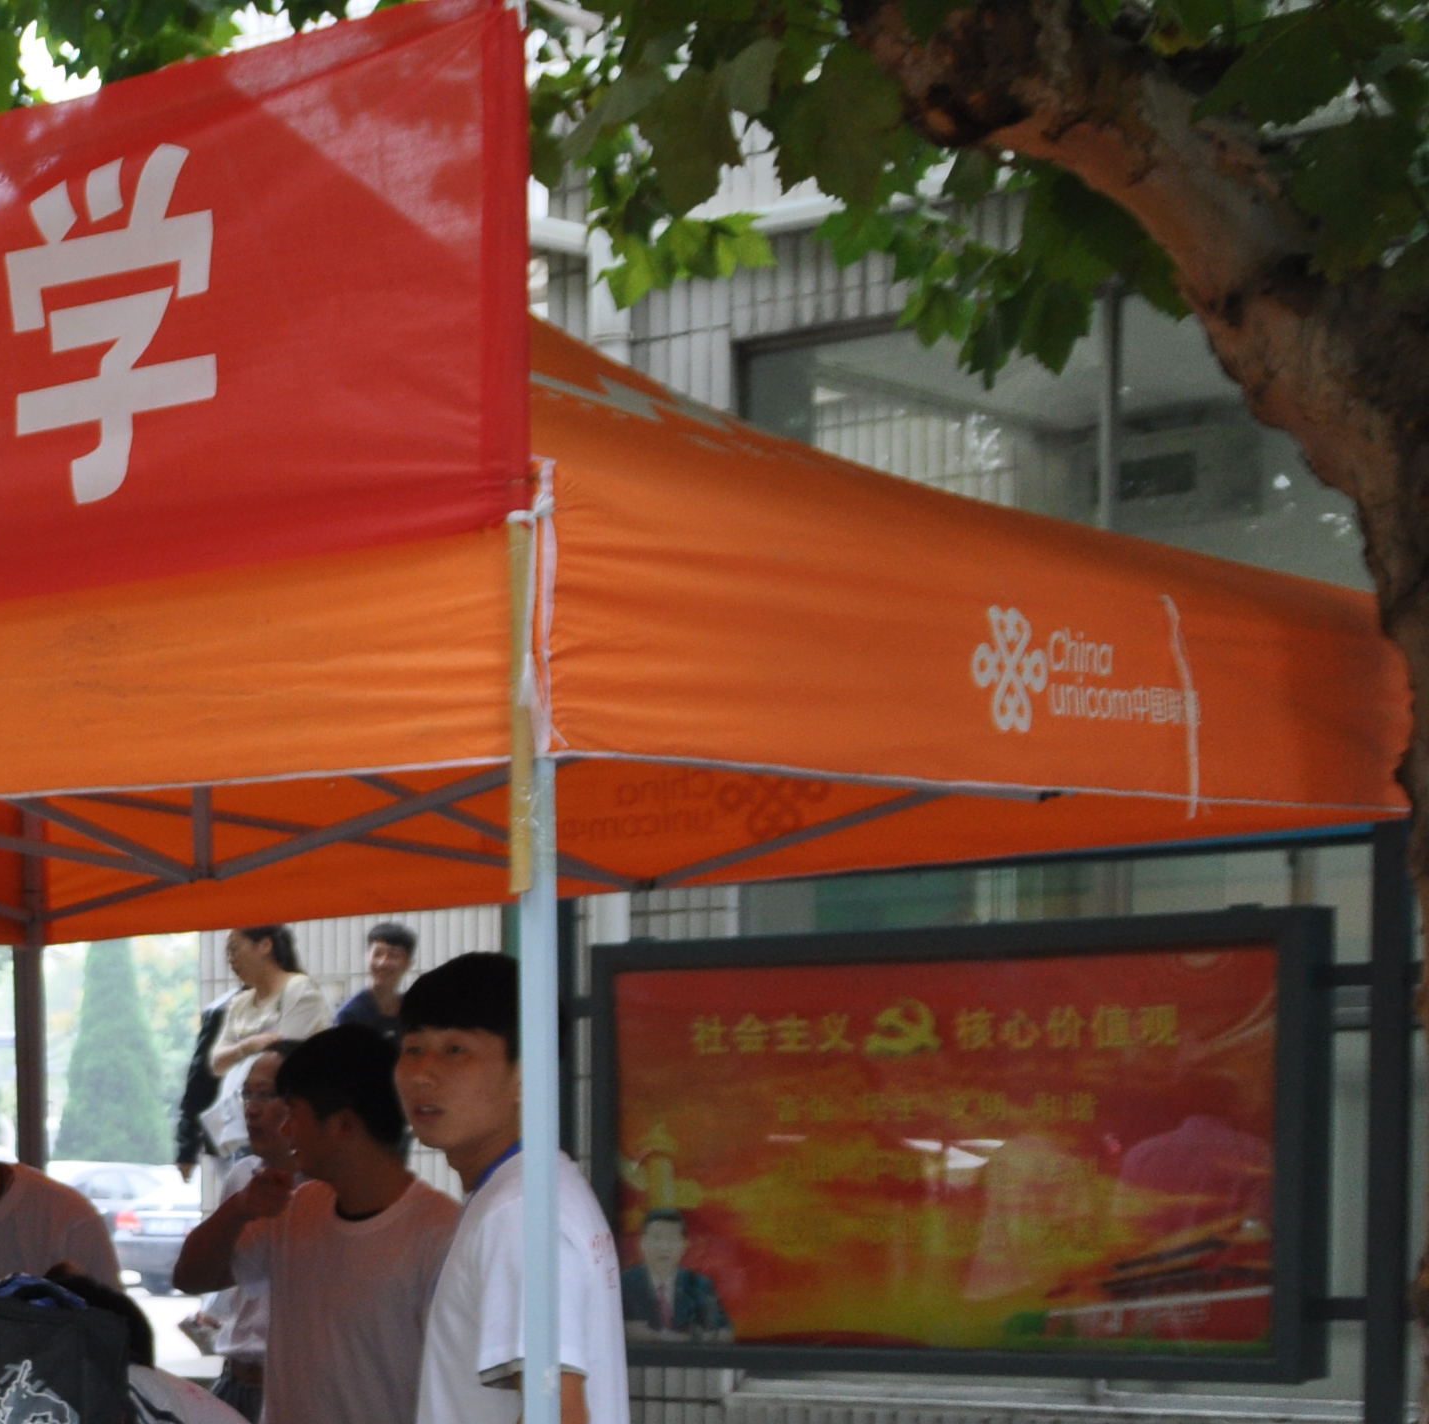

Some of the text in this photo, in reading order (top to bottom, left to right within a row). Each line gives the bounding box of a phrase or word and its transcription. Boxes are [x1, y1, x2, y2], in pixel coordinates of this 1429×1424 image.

[1048, 626, 1113, 676] China
[691, 1012, 854, 1056] 社会主义
[954, 1003, 1180, 1052] 核心价值观
